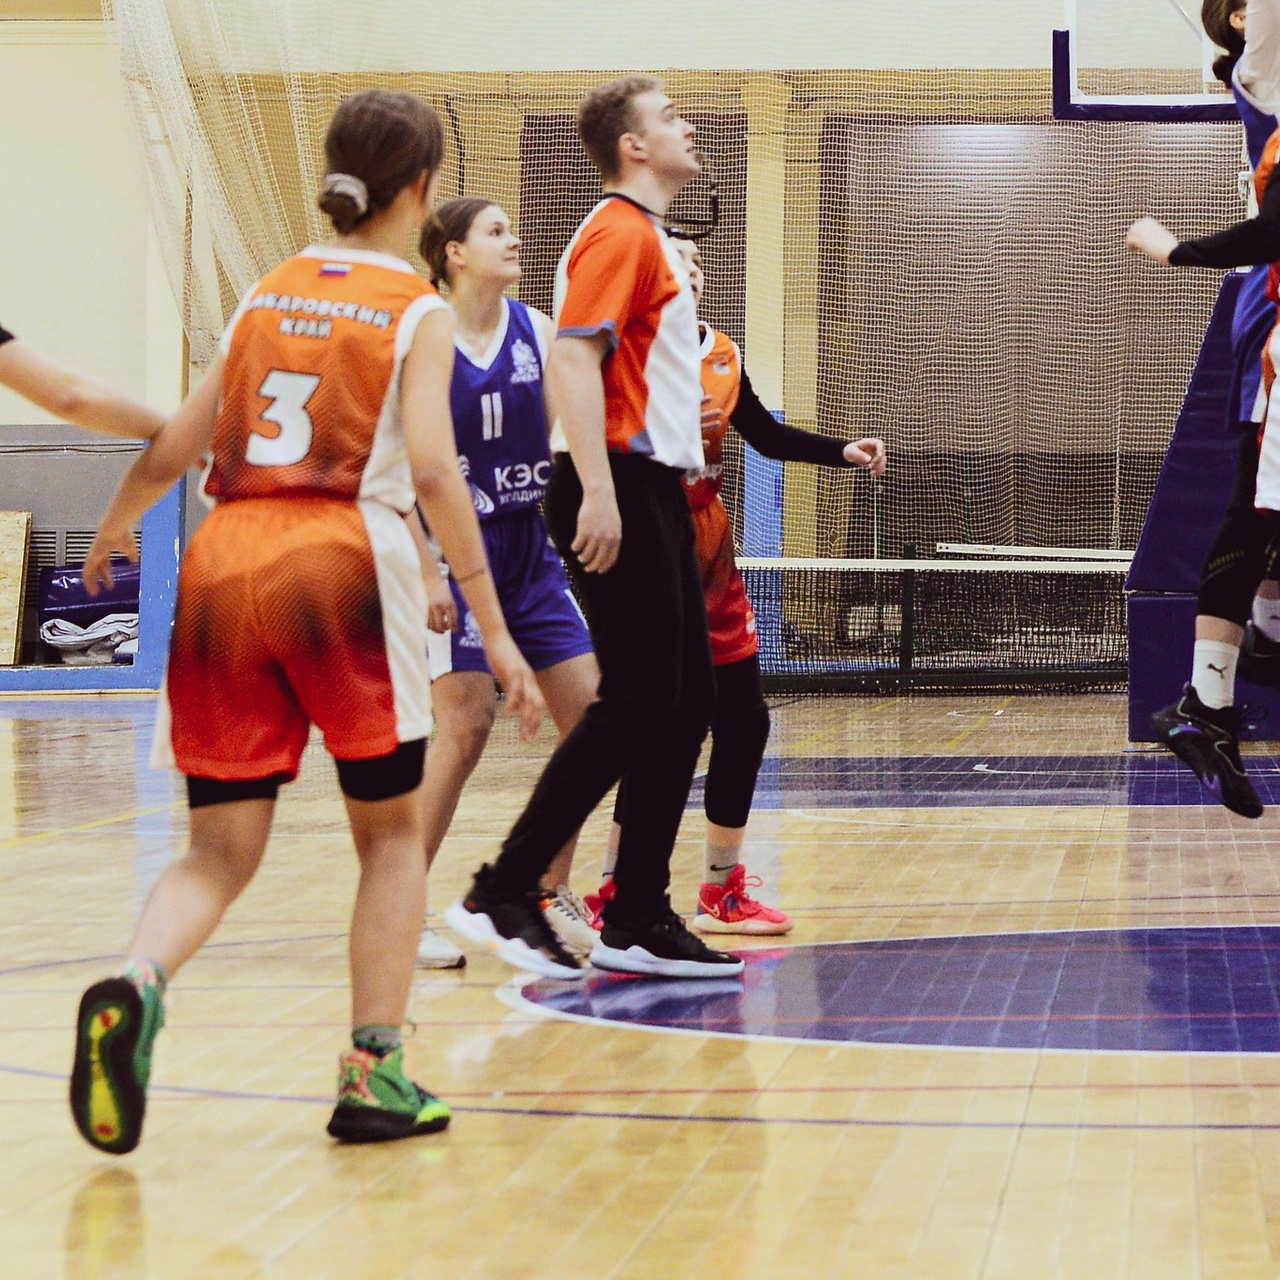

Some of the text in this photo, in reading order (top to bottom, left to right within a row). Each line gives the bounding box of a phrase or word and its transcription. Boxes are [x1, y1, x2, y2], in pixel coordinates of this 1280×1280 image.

[245, 369, 321, 466] 3
[480, 392, 503, 441] 11
[494, 460, 550, 491] КЭС
